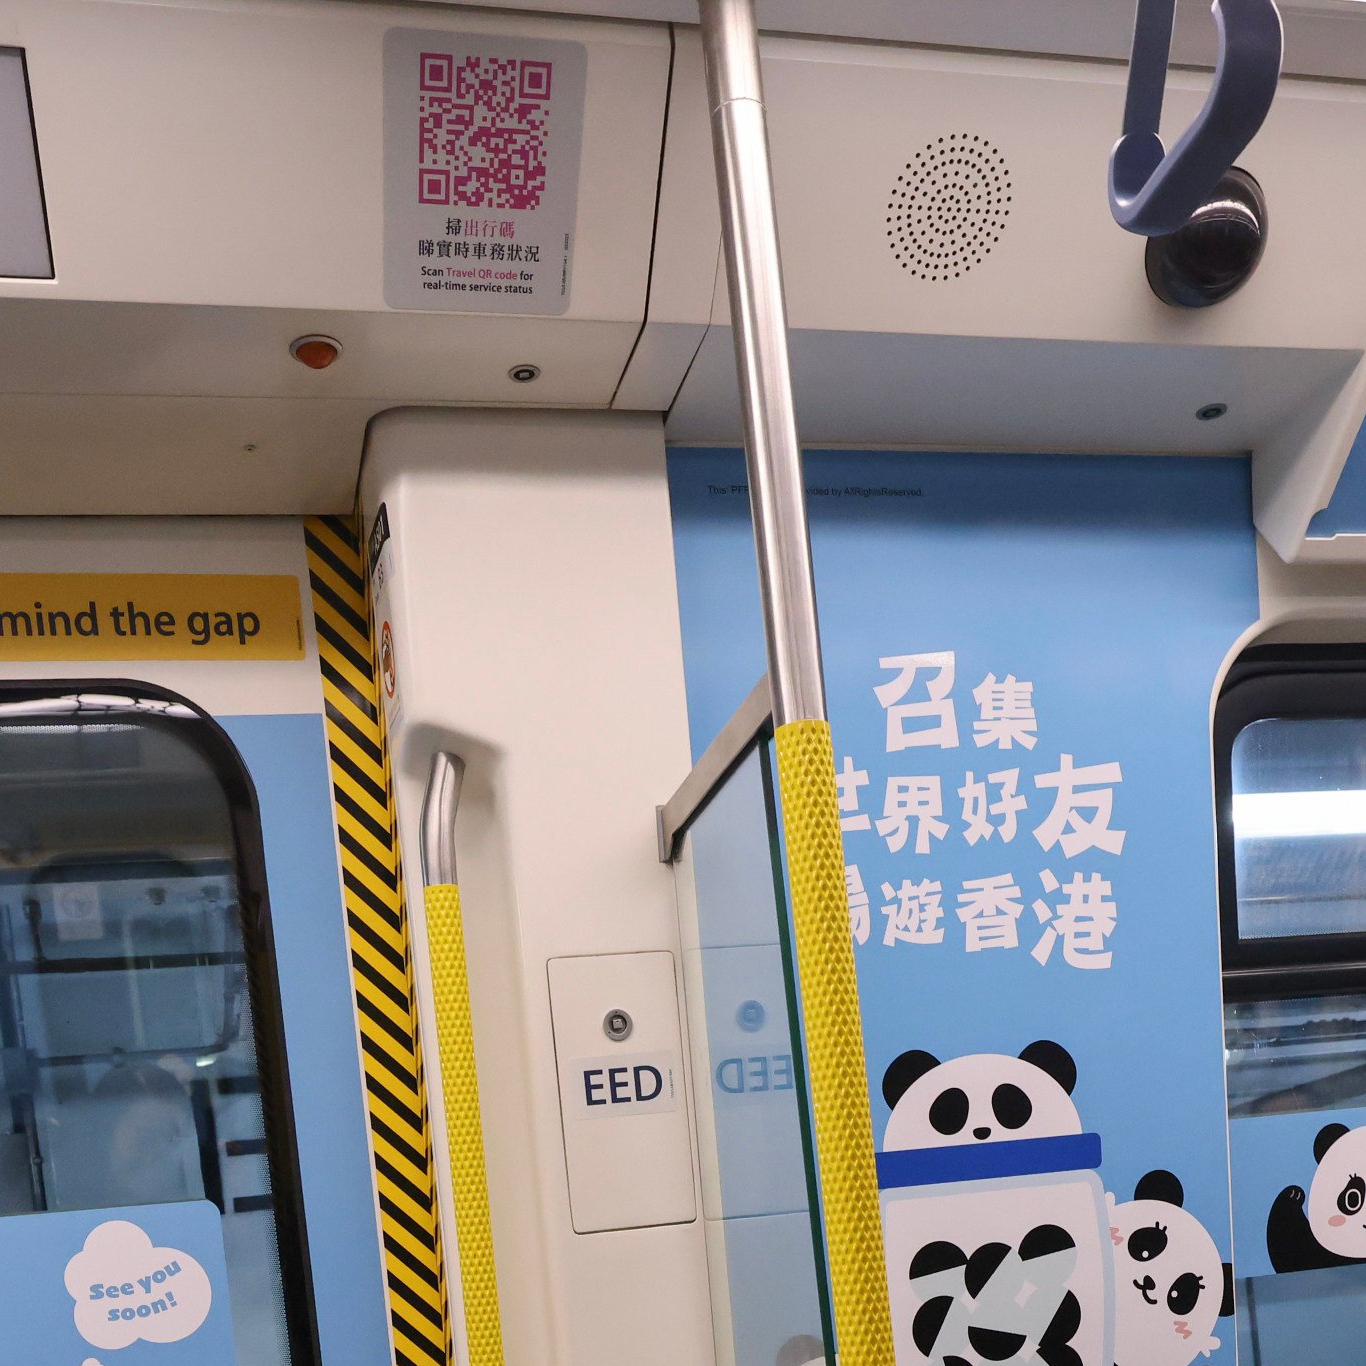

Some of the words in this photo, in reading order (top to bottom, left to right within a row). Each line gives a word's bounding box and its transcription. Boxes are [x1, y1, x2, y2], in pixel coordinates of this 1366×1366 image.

[446, 217, 515, 239] 掃出行碼
[418, 239, 540, 263] 睇實時車務狀況
[421, 266, 444, 277] Scan
[446, 267, 476, 279] Travel
[478, 269, 492, 280] QR
[494, 270, 518, 280] code
[519, 271, 534, 281] for
[423, 280, 466, 291] real-time
[469, 282, 501, 293] service
[504, 284, 533, 294] status
[110, 601, 176, 637] the
[187, 610, 261, 646] gap
[873, 650, 1038, 753] 召集
[583, 1065, 663, 1106] EED
[89, 1283, 134, 1301] See
[137, 1260, 183, 1294] you
[107, 1291, 178, 1322] soon!
